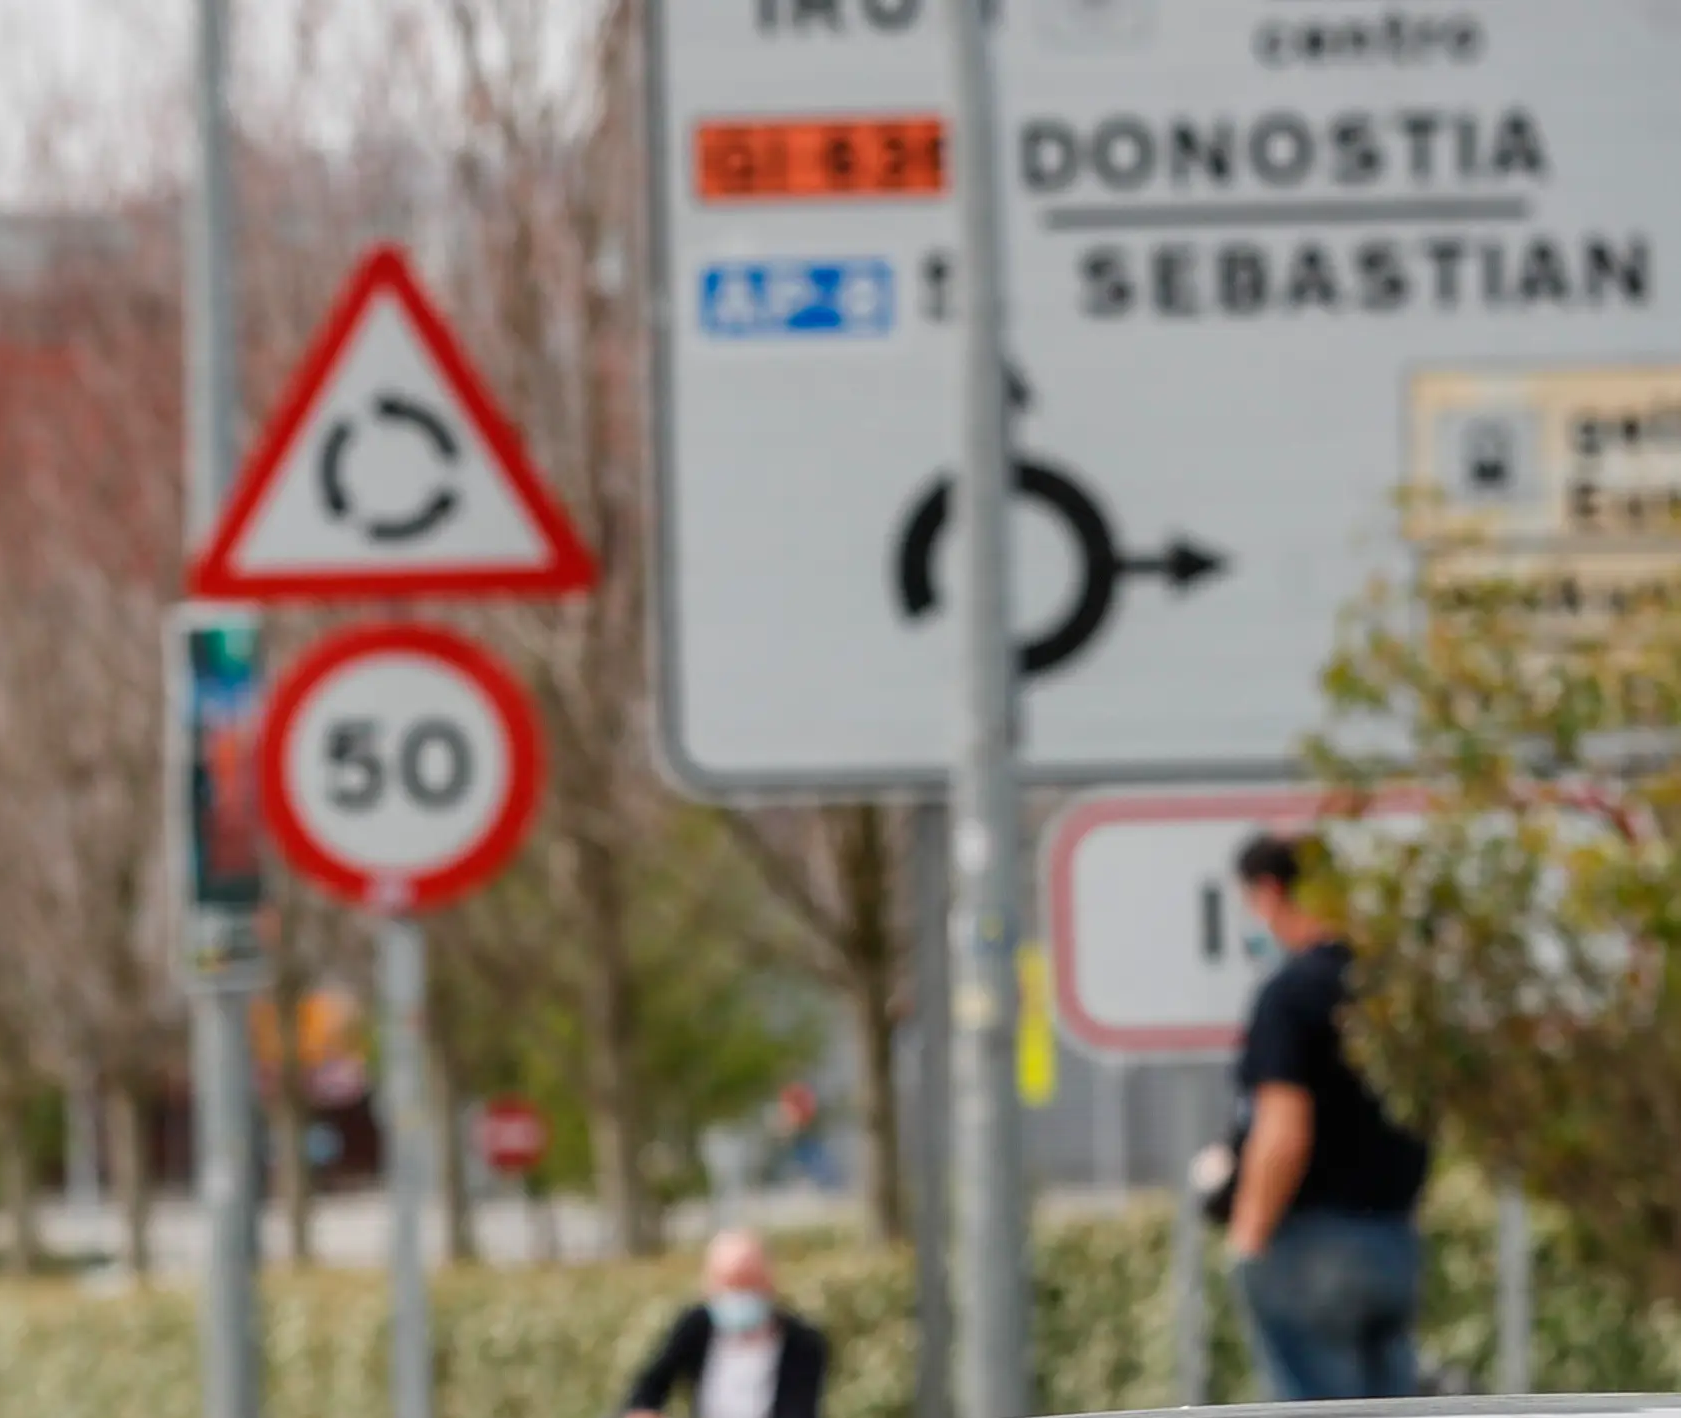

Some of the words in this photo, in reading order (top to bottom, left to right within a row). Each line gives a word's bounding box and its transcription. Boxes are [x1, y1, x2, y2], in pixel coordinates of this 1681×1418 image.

[1255, 10, 1487, 68] centro
[1021, 106, 1545, 190] DONOSTIA
[1079, 234, 1649, 318] SEBASTIAN
[319, 716, 471, 812] 50
